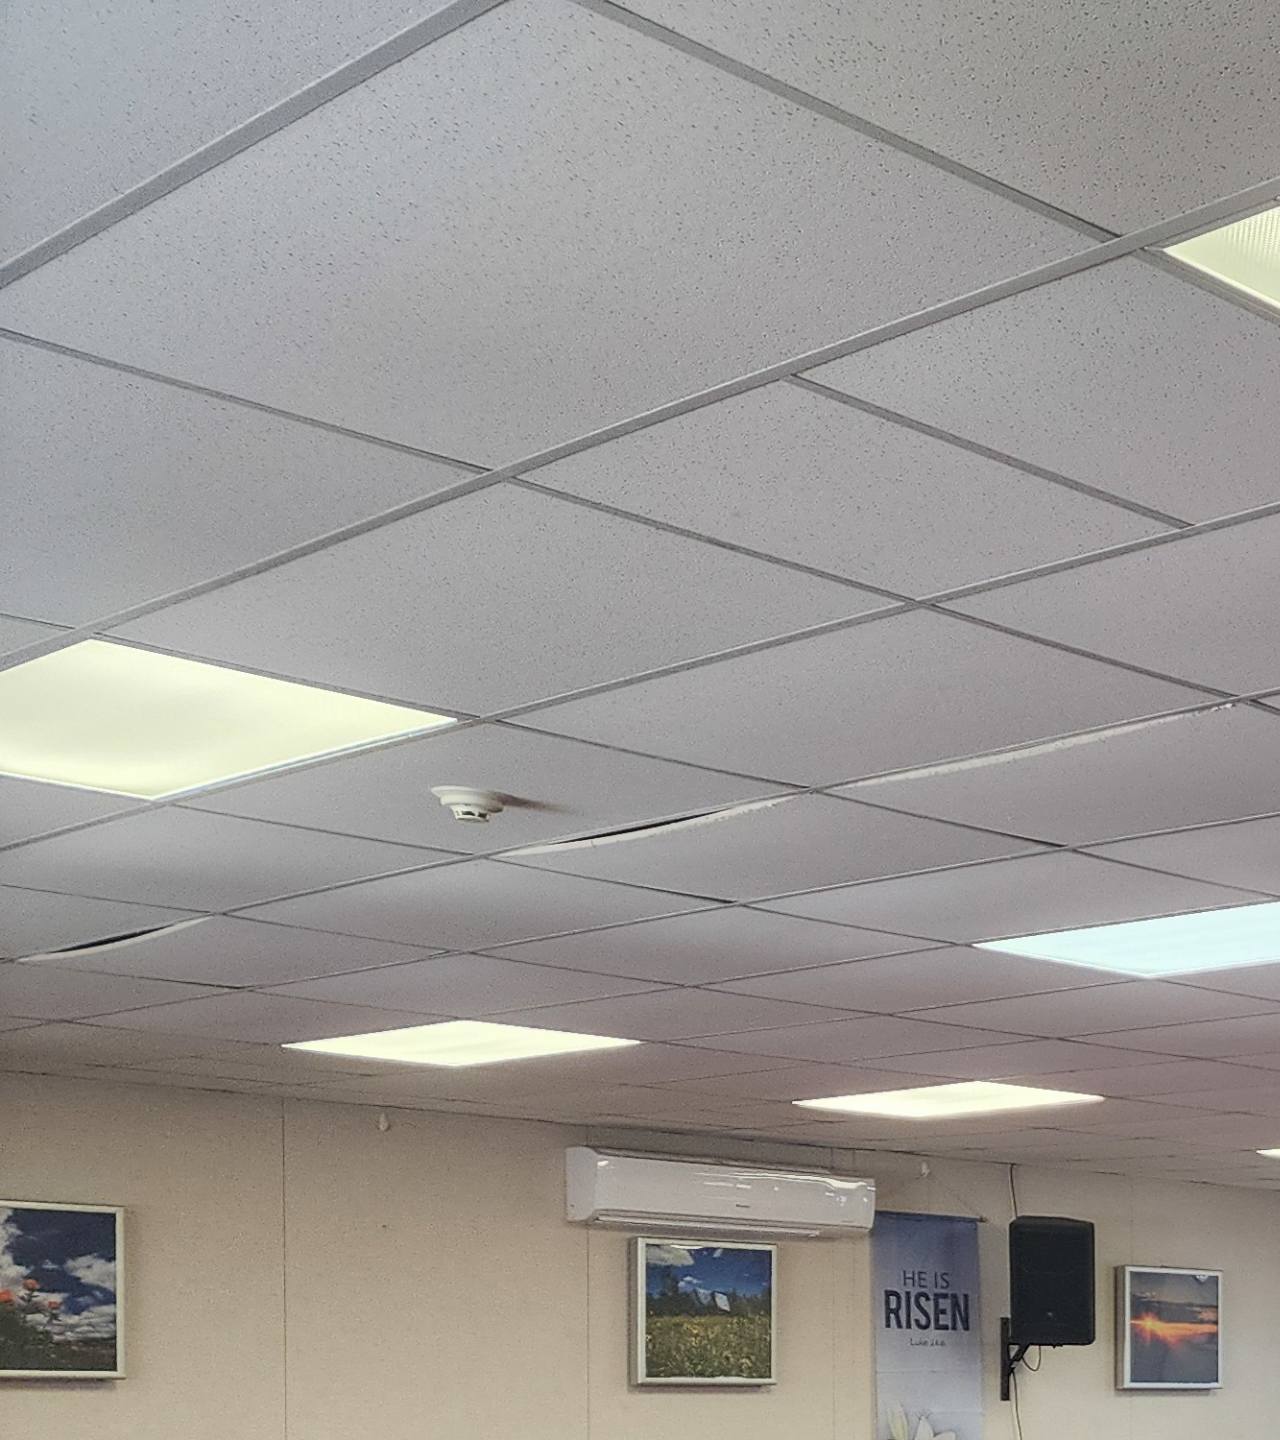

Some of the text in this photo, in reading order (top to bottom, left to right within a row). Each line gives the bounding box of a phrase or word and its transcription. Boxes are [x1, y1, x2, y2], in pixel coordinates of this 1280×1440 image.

[903, 1270, 950, 1289] HE IS
[884, 1289, 970, 1331] RISEN
